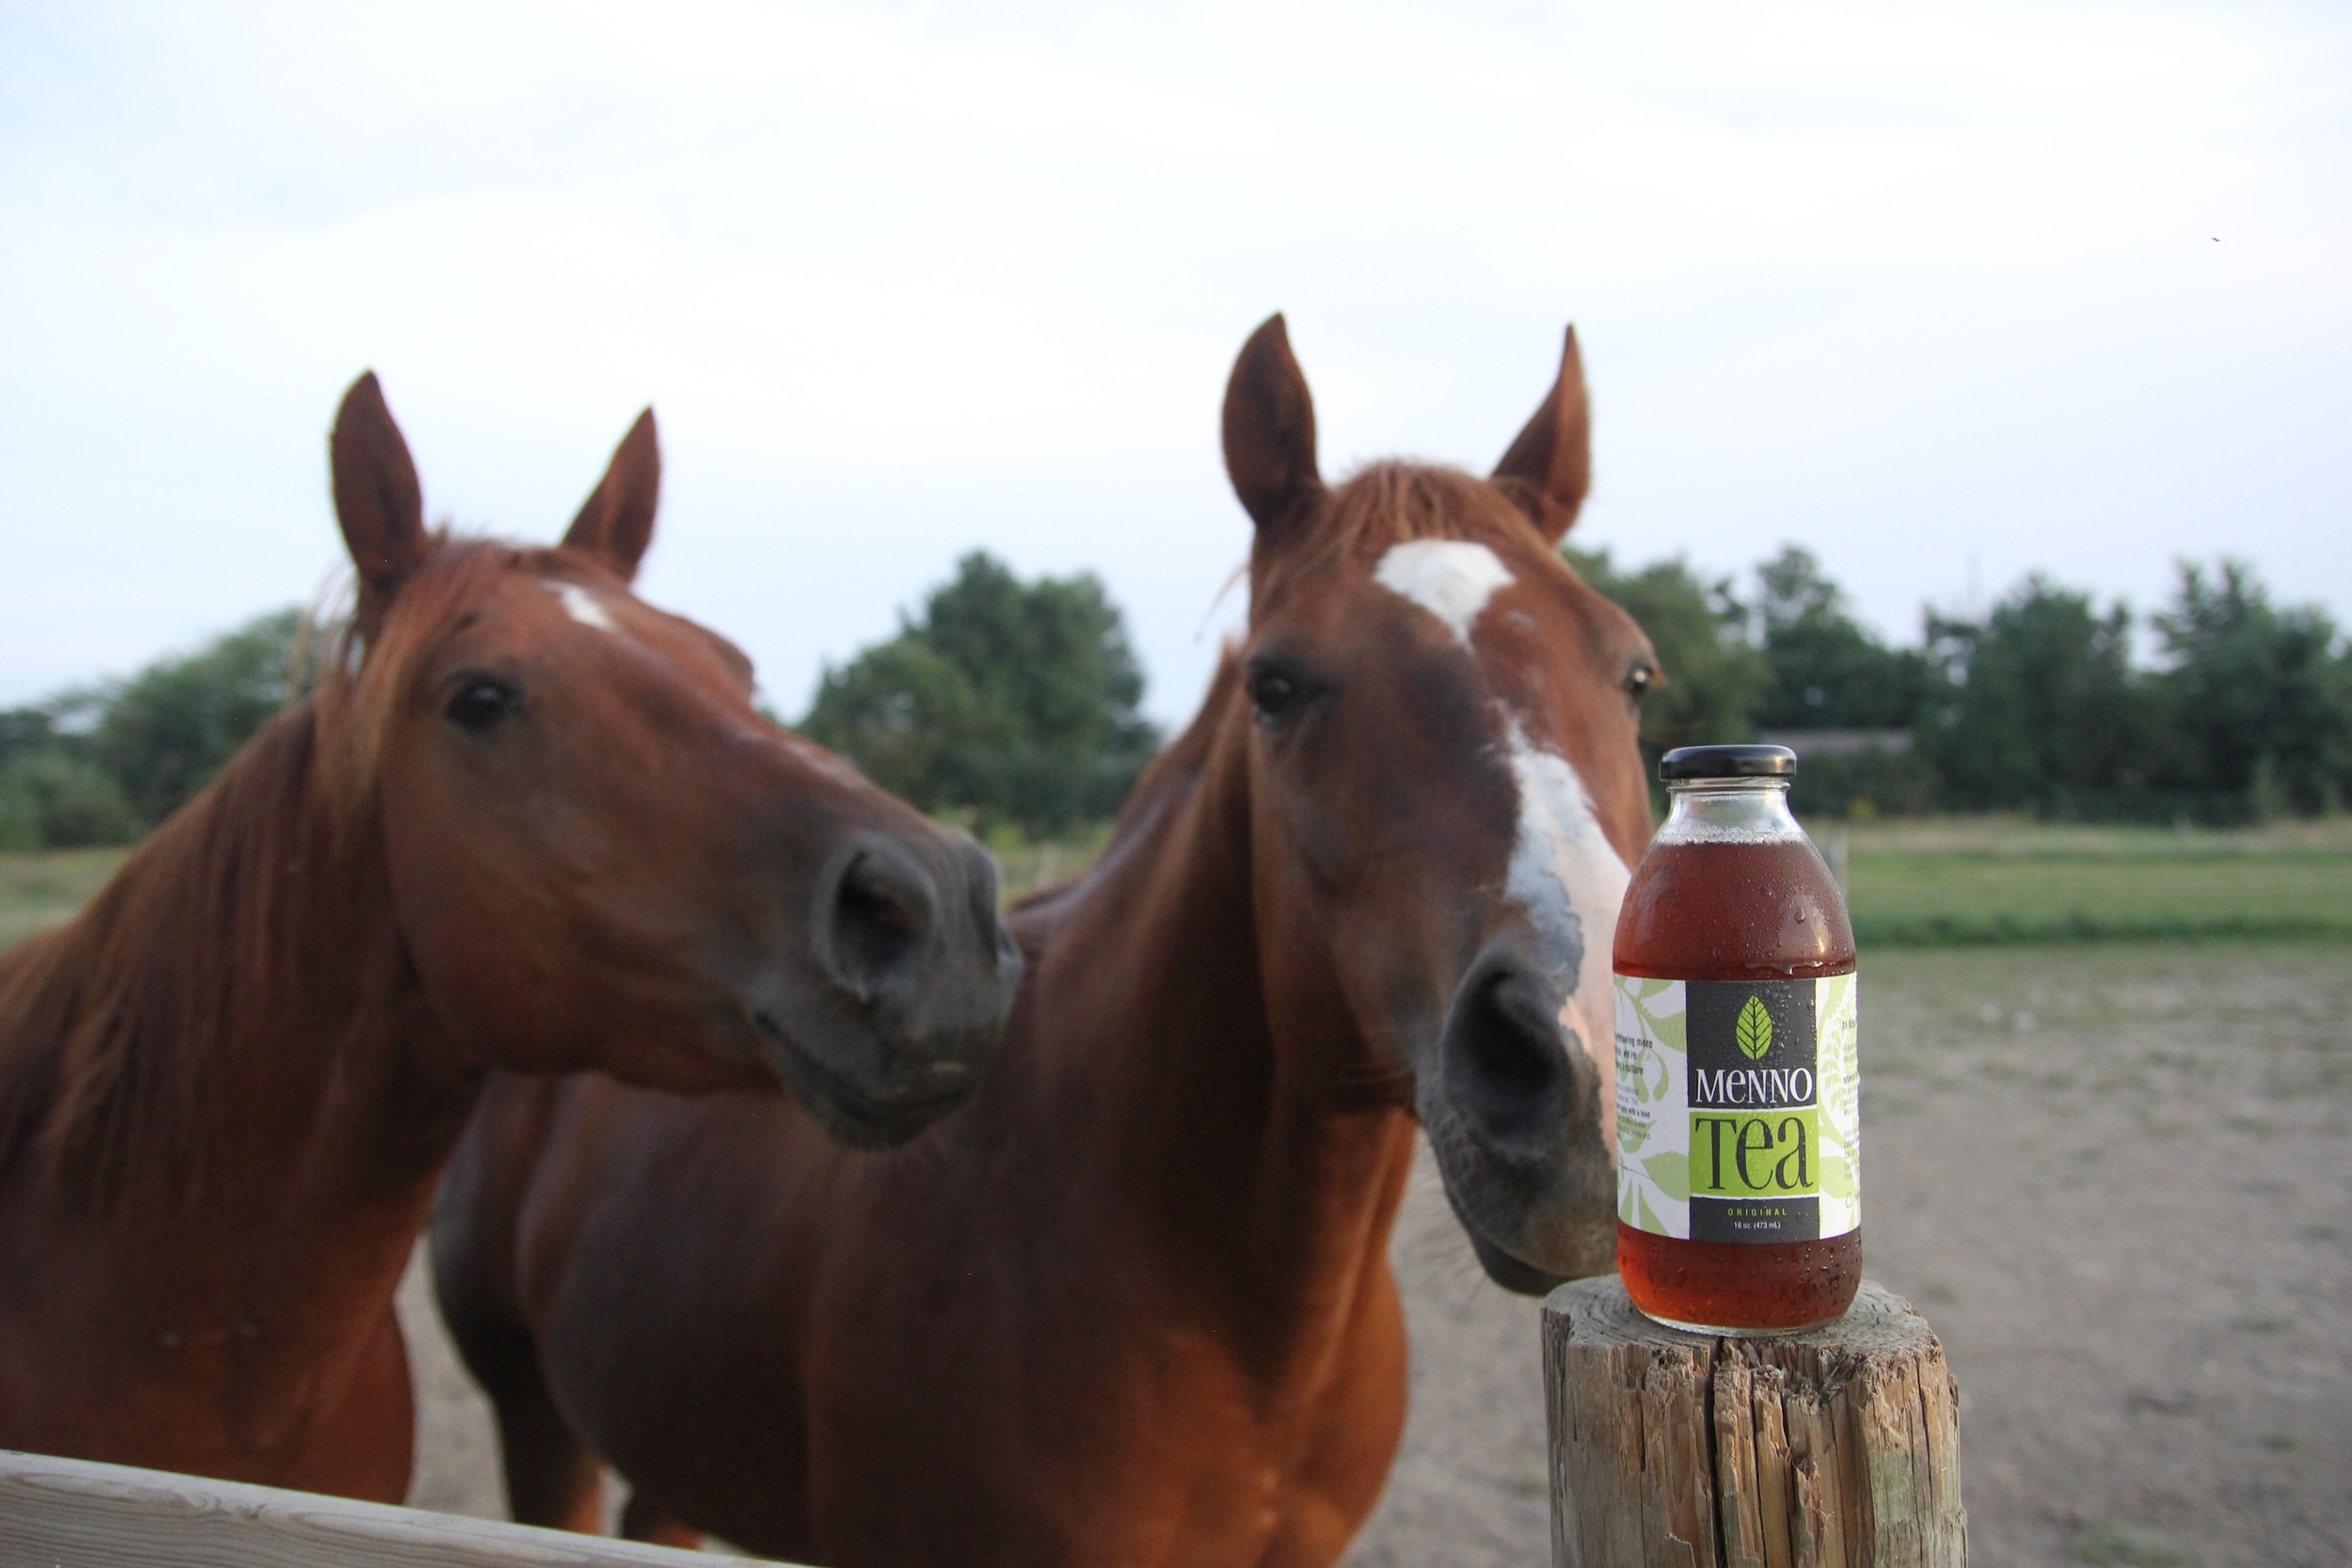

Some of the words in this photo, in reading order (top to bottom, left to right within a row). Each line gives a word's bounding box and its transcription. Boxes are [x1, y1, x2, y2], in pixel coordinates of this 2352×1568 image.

[1636, 1038, 1653, 1049] more
[1695, 1117, 1813, 1190] Tea
[1727, 1208, 1788, 1216] ORIGINAL
[1768, 1221, 1781, 1229] mL)
